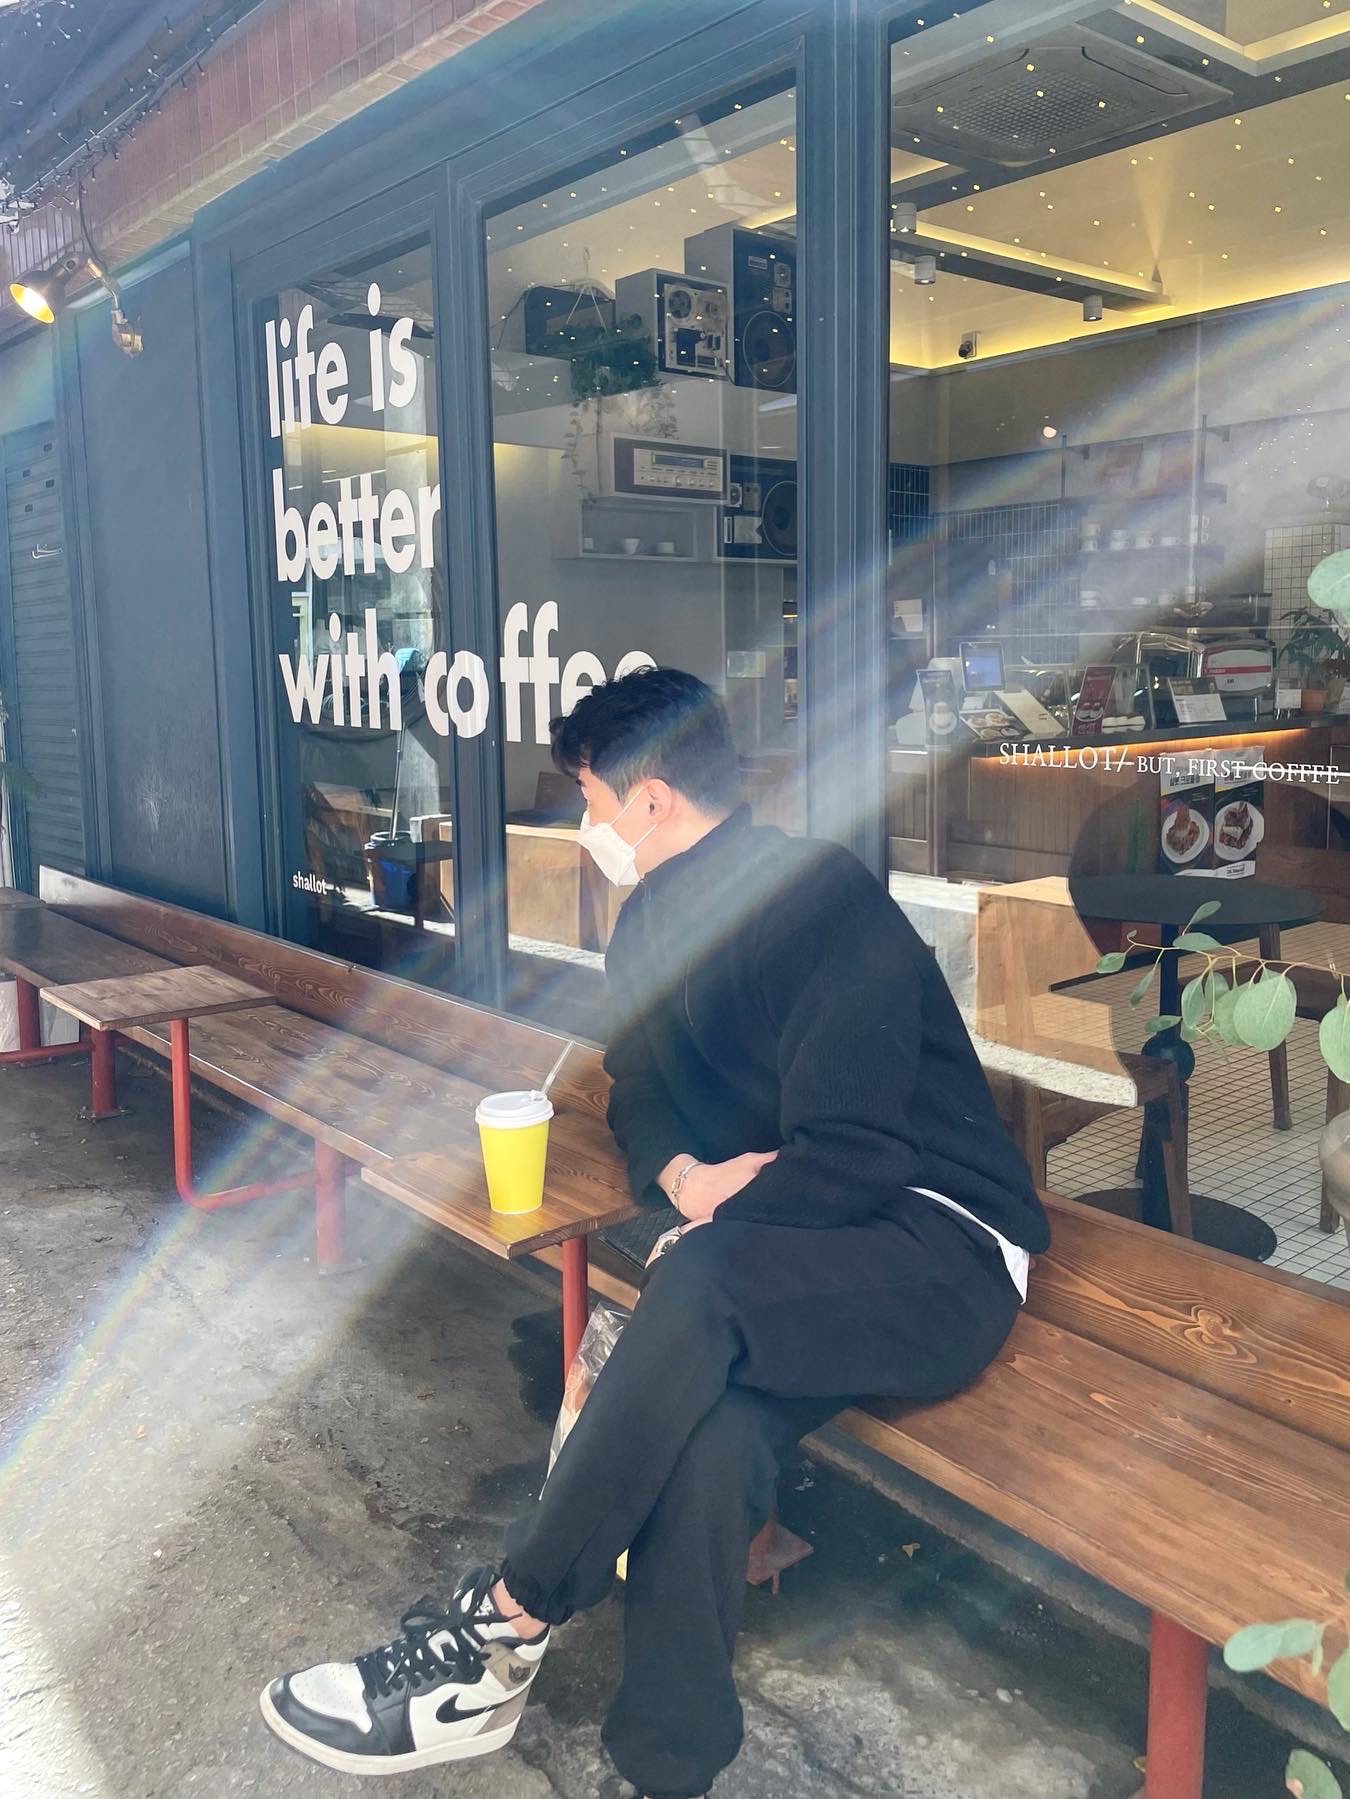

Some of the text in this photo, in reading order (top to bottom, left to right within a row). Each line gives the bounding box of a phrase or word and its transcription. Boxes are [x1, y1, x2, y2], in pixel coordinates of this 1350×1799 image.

[265, 282, 414, 438] life is
[272, 468, 441, 582] better
[278, 600, 659, 745] with coffe
[1136, 755, 1181, 777] BUT,
[1187, 758, 1246, 779] FIRST
